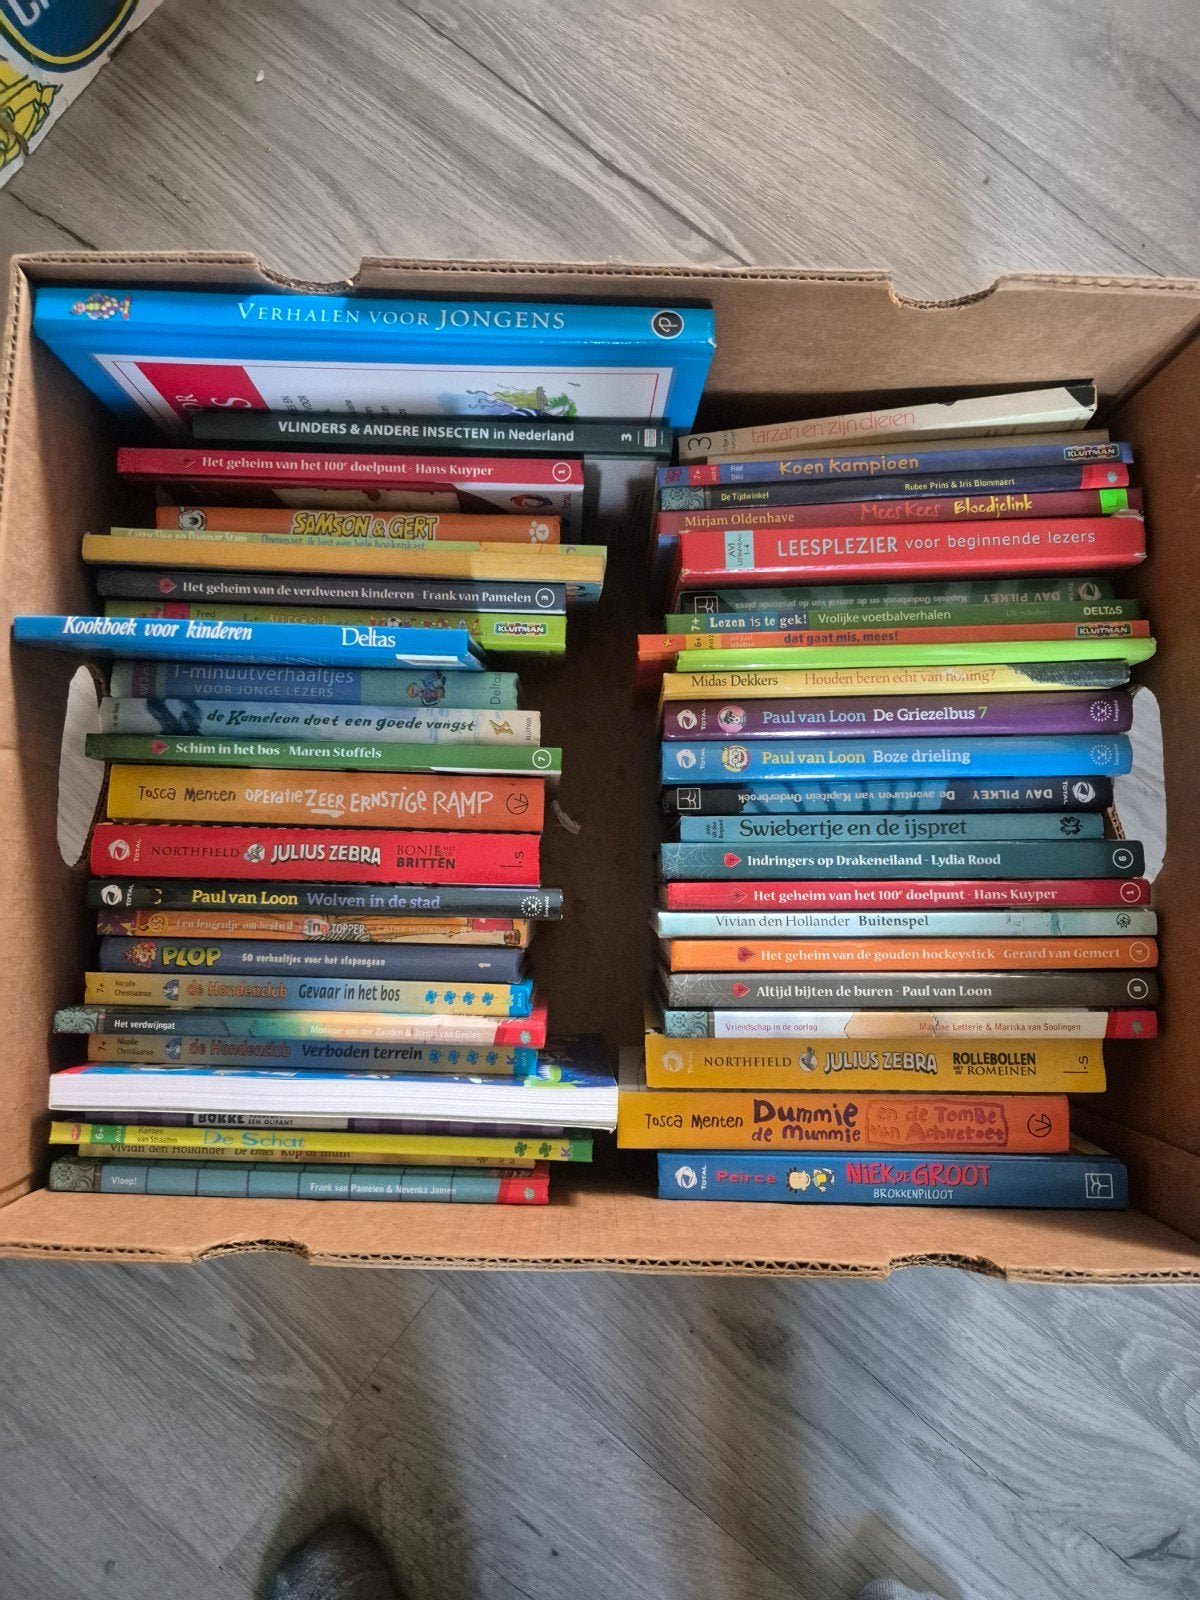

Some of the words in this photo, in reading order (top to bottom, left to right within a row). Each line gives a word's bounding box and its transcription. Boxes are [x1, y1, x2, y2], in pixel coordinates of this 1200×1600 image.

[238, 302, 360, 323] VERHALEN
[369, 310, 429, 326] VOOR
[435, 309, 565, 331] JONGENS
[278, 421, 346, 435] VLINDERS
[350, 422, 360, 435] &
[363, 423, 419, 437] ANDERE
[422, 426, 490, 439] INSECTEN
[494, 428, 506, 439] in
[509, 429, 574, 442] Nederland
[1067, 447, 1115, 458] KLUITMAN
[779, 461, 824, 476] Koen
[904, 482, 927, 491] Ruben
[930, 481, 949, 490] Prins
[951, 480, 958, 488] &
[959, 479, 972, 487] Iris
[974, 478, 1015, 487] Blommaert
[721, 493, 731, 501] De
[732, 491, 769, 501] Tijdwinkel
[292, 509, 371, 538] SAMSON
[371, 521, 385, 538] &
[388, 515, 438, 541] GERT
[685, 514, 728, 528] Mirjam
[731, 512, 795, 525] Oldenhave
[728, 543, 736, 557] AVI
[777, 536, 898, 557] LEESPLEZIER
[905, 538, 940, 549] voor
[947, 531, 1041, 551] beginnende
[1048, 530, 1096, 544] lezers
[183, 581, 204, 592] Het
[206, 583, 250, 596] geheim
[253, 586, 274, 595] van
[278, 584, 291, 596] de
[294, 585, 359, 598] verdwenen
[361, 588, 414, 599] kinderen
[423, 589, 457, 601] Frank
[459, 593, 479, 601] van
[482, 591, 532, 603] Pamelen
[818, 613, 860, 625] Vrolijke
[861, 608, 951, 623] voetbalverhalen
[1083, 605, 1123, 615] DELTAS
[62, 617, 137, 635] Kookboek
[144, 624, 179, 636] voor
[185, 621, 253, 641] kinderen
[498, 625, 545, 634] KLUITMAN
[709, 617, 746, 628] Lezen
[750, 616, 761, 626] is
[764, 616, 775, 626] te
[780, 615, 808, 629] gek!
[341, 627, 396, 648] Deltas
[783, 632, 804, 644] dat
[806, 632, 833, 645] gaat
[836, 631, 860, 643] mis,
[863, 631, 898, 642] mees!
[1079, 626, 1128, 635] KLUITMAN
[691, 675, 727, 687] Midas
[730, 674, 779, 687] Dekkers
[206, 709, 224, 722] de
[225, 710, 300, 725] Kameleon
[304, 714, 338, 727] doet
[344, 716, 372, 727] een
[375, 718, 423, 732] goede
[426, 720, 475, 733] vangst
[763, 711, 796, 724] Paul
[798, 714, 826, 724] van
[829, 710, 866, 723] Loon
[873, 709, 894, 722] De
[897, 707, 976, 721] Griezelbus
[978, 706, 987, 719] 7
[175, 743, 214, 754] Schim
[218, 744, 232, 754] in
[234, 745, 255, 755] het
[257, 745, 280, 756] bos
[289, 746, 329, 757] Maren
[333, 747, 382, 759] Stoffels
[762, 751, 795, 764] Paul
[798, 754, 825, 764] van
[828, 750, 866, 764] Loon
[873, 750, 908, 763] Boze
[911, 749, 971, 764] drieling
[138, 785, 176, 801] Tosca
[184, 787, 236, 802] Menten
[971, 789, 1019, 801] PILKEY
[1025, 788, 1053, 800] DAV
[305, 789, 346, 808] ZEER
[432, 791, 494, 818] RAMP
[739, 819, 843, 839] Swiebertje
[847, 825, 871, 836] en
[875, 820, 899, 836] de
[904, 819, 967, 839] ijspret
[152, 846, 240, 858] NORTHFIELD
[271, 844, 325, 864] JULIUS
[329, 844, 382, 866] ZEBRA
[396, 858, 456, 870] BRITTEN
[748, 855, 814, 867] Indringers
[817, 858, 834, 868] op
[836, 854, 922, 866] Drakeneiland
[931, 854, 966, 867] Lydia
[968, 854, 1001, 865] Rood
[126, 884, 135, 907] TOTAL
[192, 890, 226, 904] Paul
[229, 893, 258, 904] van
[260, 891, 299, 906] Loon
[306, 893, 365, 907] Wolven
[369, 894, 385, 907] in
[388, 894, 407, 908] de
[410, 895, 441, 909] stad
[753, 890, 775, 901] Het
[779, 890, 827, 903] geheim
[829, 893, 852, 901] van
[854, 890, 876, 901] het
[906, 889, 965, 902] doelpunt
[974, 889, 1007, 900] Hans
[1010, 889, 1057, 902] Kuyper
[715, 916, 756, 927] Vivian
[759, 915, 782, 927] den
[786, 915, 850, 927] Hollander
[858, 914, 929, 928] Buitenspel
[162, 946, 222, 967] PLOP
[115, 980, 136, 988] Nicolle
[186, 980, 204, 996] de
[208, 982, 289, 999] Hondenclub
[114, 989, 152, 998] Christiaanse
[298, 983, 340, 1000] Gevaar
[343, 985, 354, 1000] in
[358, 984, 376, 1001] het
[380, 985, 400, 1001] bos
[756, 986, 792, 998] Altijd
[794, 986, 833, 999] bijten
[836, 986, 851, 997] de
[853, 986, 893, 997] buren
[902, 985, 930, 997] Paul
[932, 988, 956, 997] van
[959, 985, 992, 997] Loon
[114, 1019, 128, 1028] Het
[130, 1020, 175, 1031] verdwijngat
[704, 1056, 792, 1067] NORTHFIELD
[823, 1050, 879, 1073] JULIUS
[882, 1052, 938, 1075] ZEBRA
[953, 1052, 1036, 1066] ROLLEBOLLEN
[967, 1065, 1037, 1076] ROMEINEN
[753, 1098, 858, 1128] Dummie
[644, 1113, 683, 1129] Tosca
[691, 1113, 743, 1130] Menten
[204, 1130, 234, 1146] De
[241, 1130, 305, 1148] Schat
[751, 1127, 773, 1142] de
[782, 1125, 861, 1144] Mummie
[111, 1176, 137, 1186] Vloep!
[715, 1169, 777, 1184] Peirce
[911, 1163, 991, 1187] GROOT
[873, 1188, 954, 1200] BROKKENPILOOT
